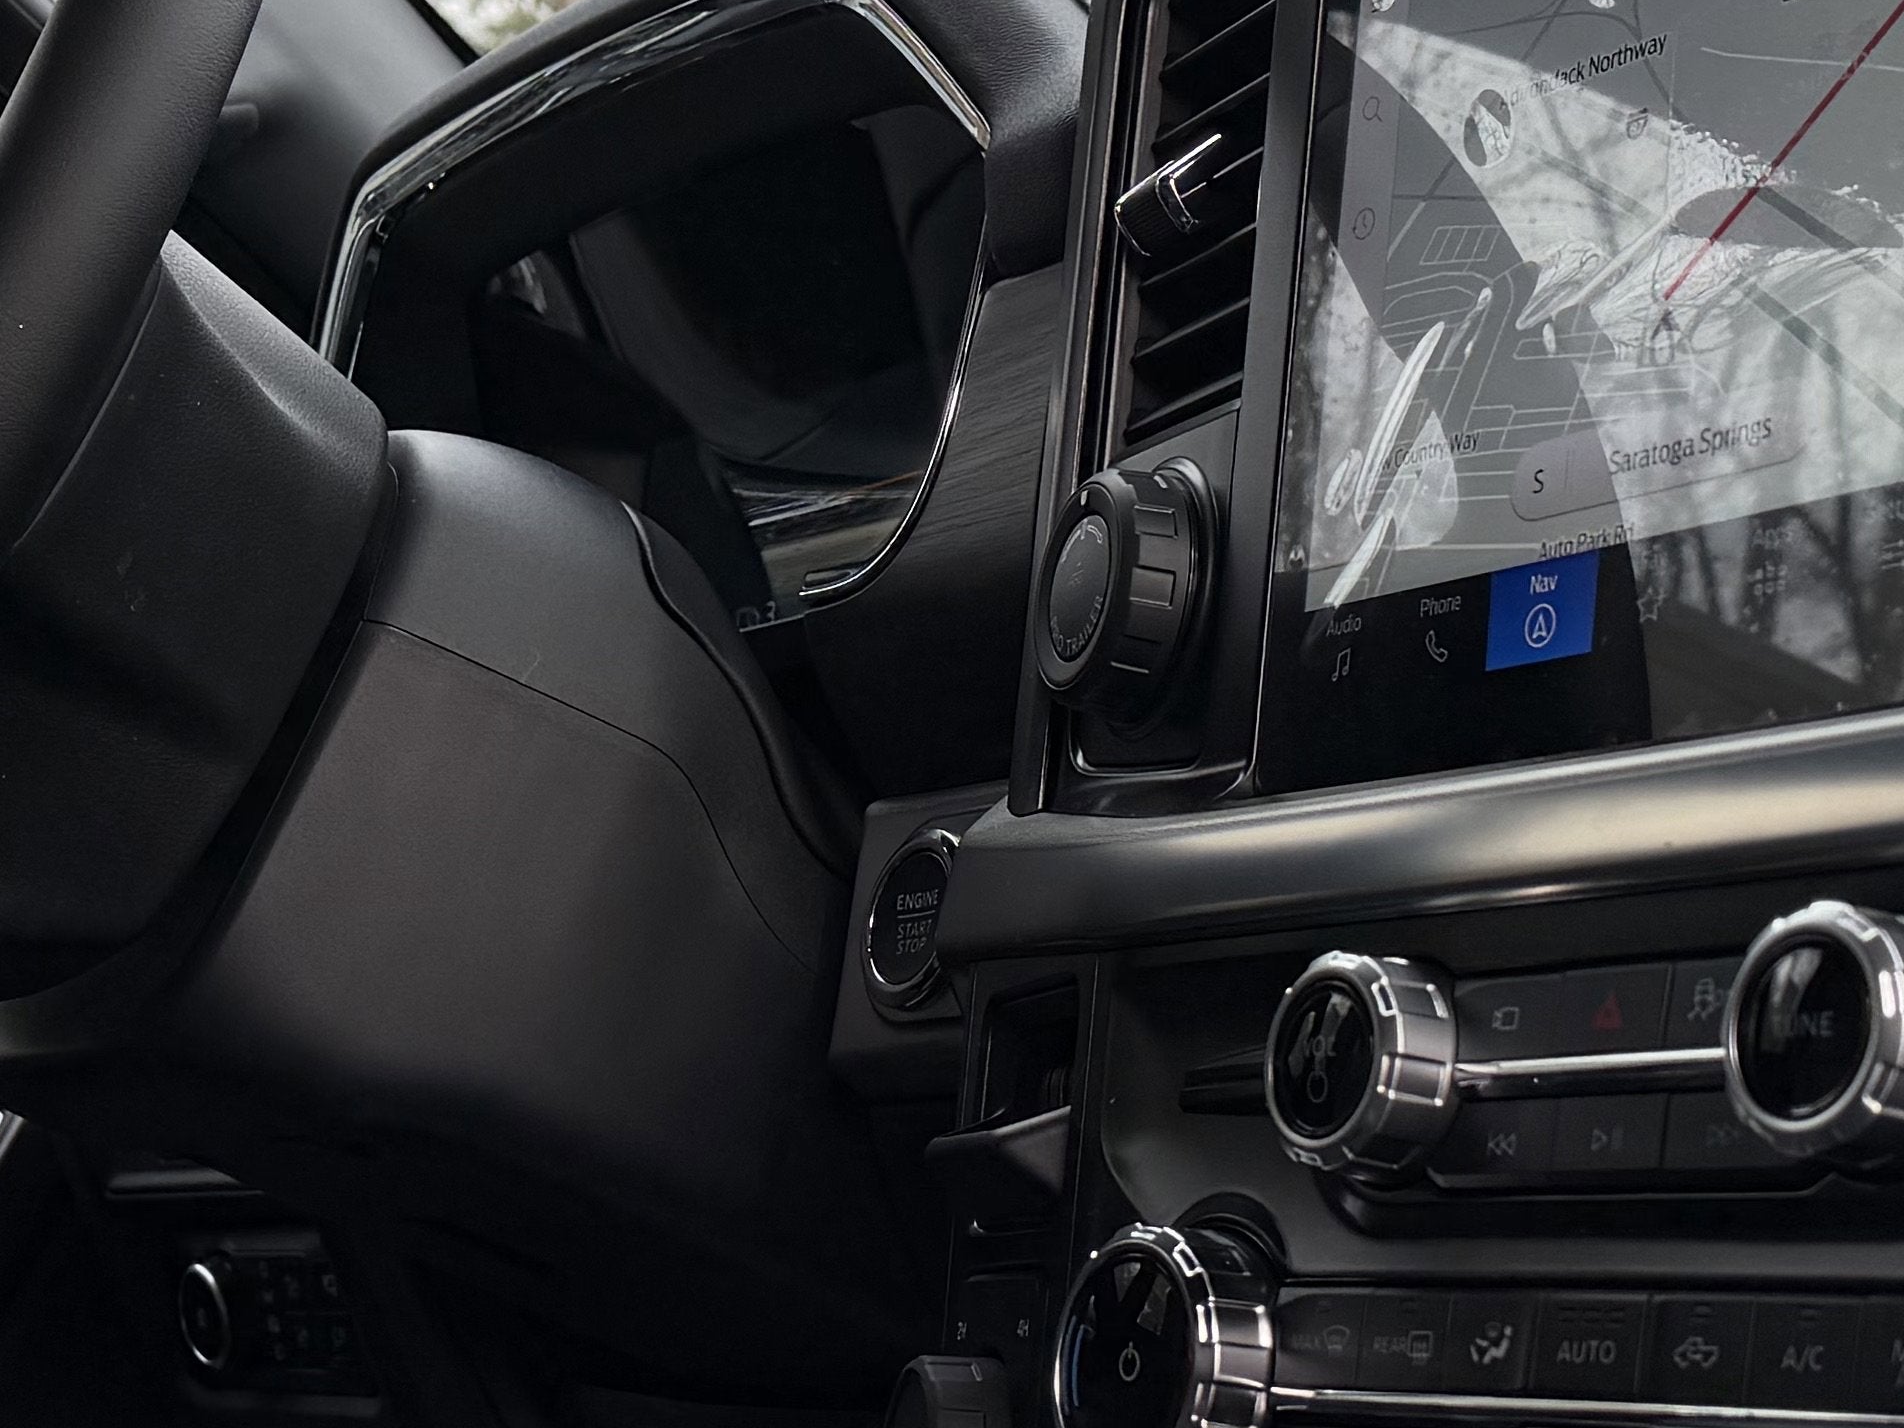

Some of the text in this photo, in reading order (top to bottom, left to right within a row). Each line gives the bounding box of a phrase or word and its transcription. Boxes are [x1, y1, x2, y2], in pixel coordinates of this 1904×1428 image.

[1588, 35, 1668, 77] Northway
[1395, 440, 1448, 471] Country
[1450, 431, 1480, 455] Way
[1533, 416, 1773, 494] S Saratoga Springs
[1539, 539, 1574, 560] Auto
[1577, 528, 1611, 549] Park
[1529, 574, 1558, 596] Nav
[1420, 594, 1462, 619] Phone
[1326, 613, 1363, 637] Audio
[897, 889, 939, 911] ENGINE
[897, 919, 932, 939] START
[896, 936, 927, 955] STOP
[1557, 1339, 1617, 1364] AUTO
[1780, 1345, 1824, 1372] A/C
